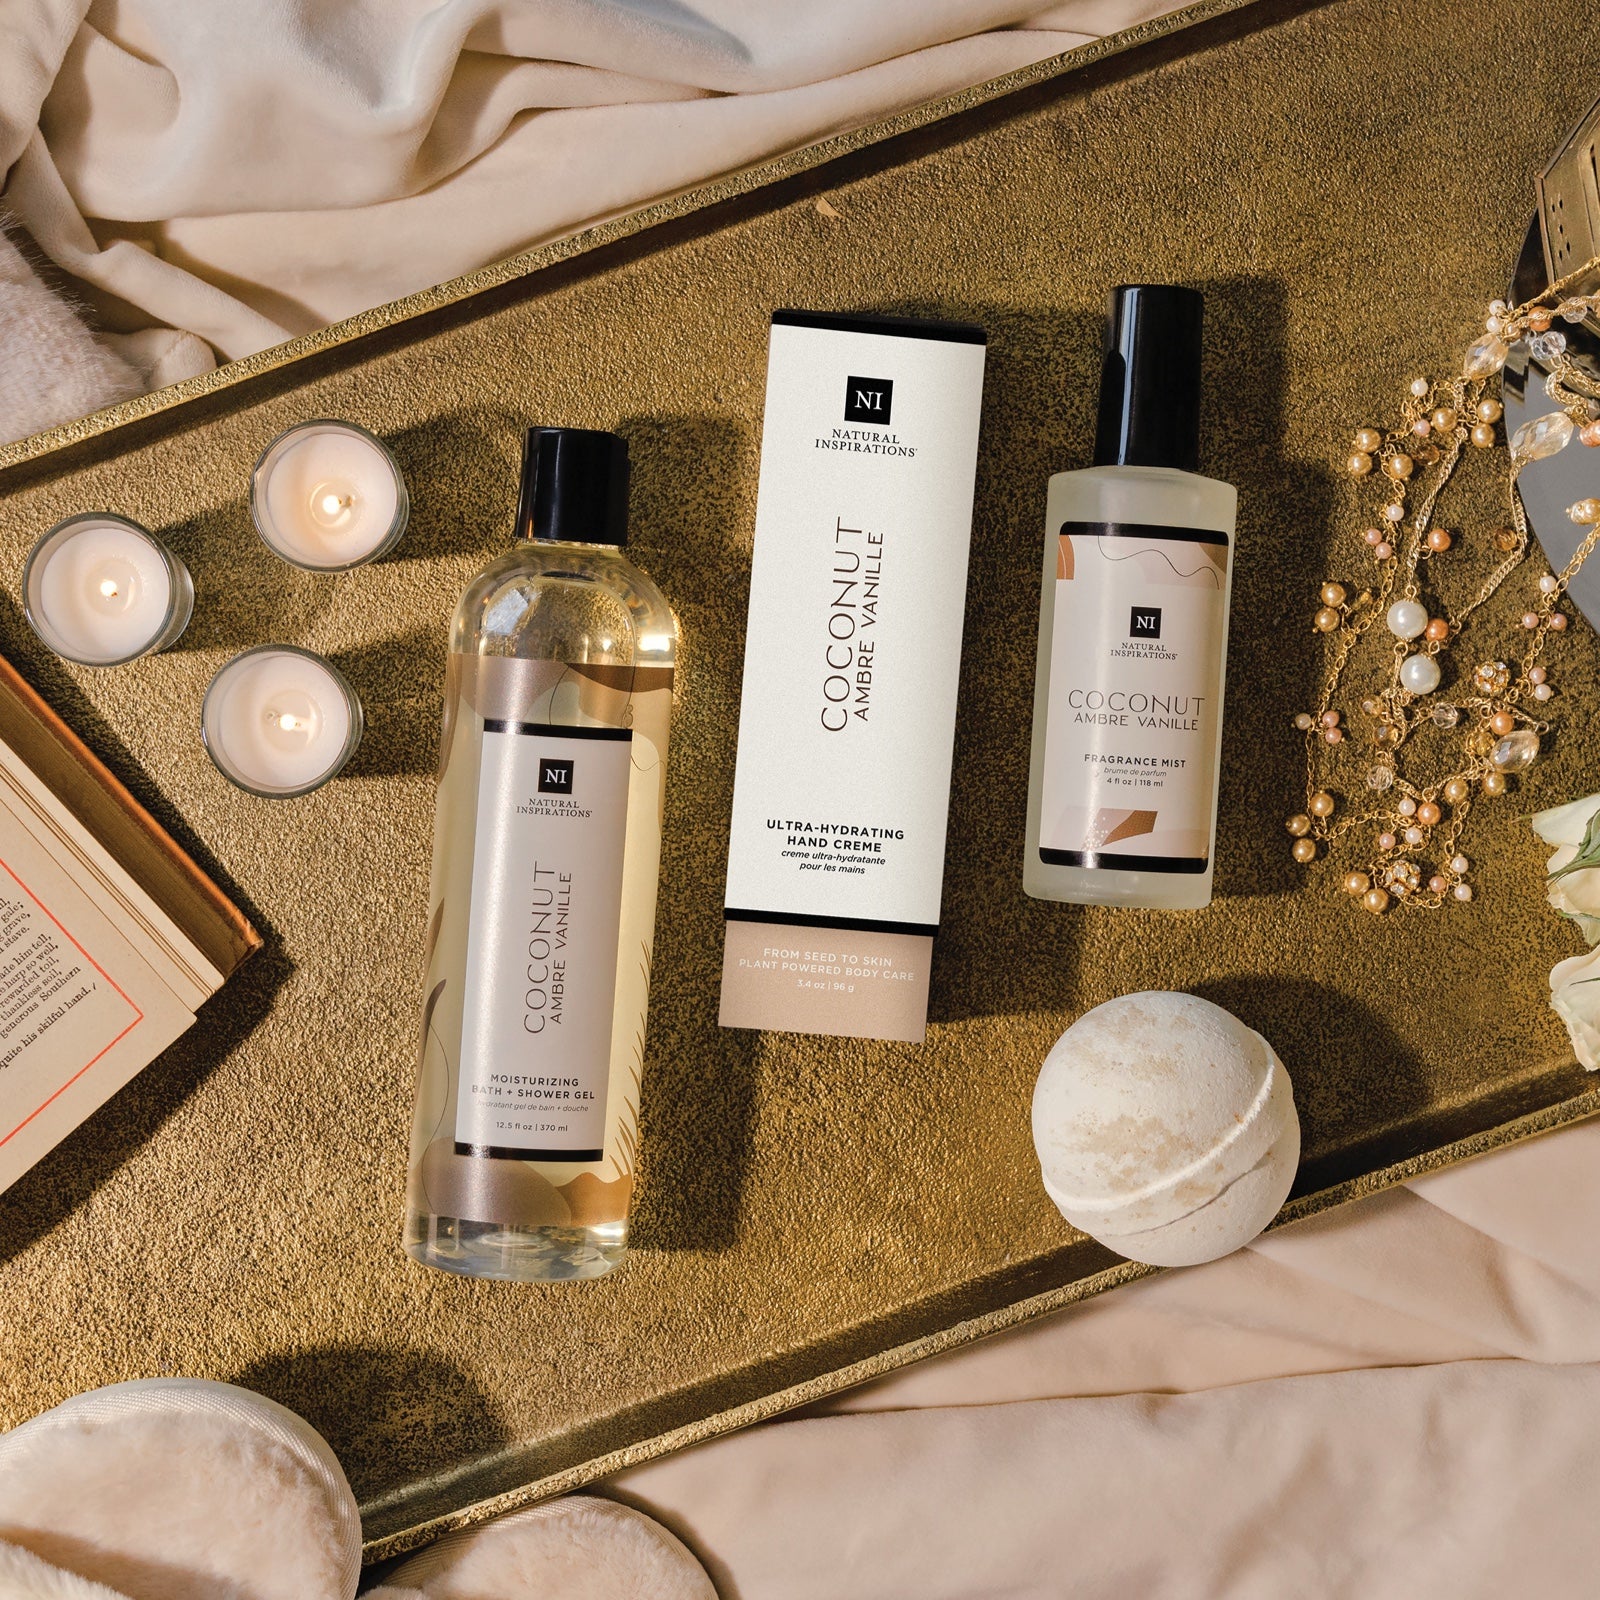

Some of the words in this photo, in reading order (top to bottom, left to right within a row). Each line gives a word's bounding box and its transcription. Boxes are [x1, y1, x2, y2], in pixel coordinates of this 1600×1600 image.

[854, 390, 884, 411] NI
[832, 428, 900, 445] NATURAL
[861, 532, 884, 628] VANILLE
[821, 516, 862, 732] COCONUT
[1136, 615, 1156, 630] NI
[1121, 642, 1167, 652] NATURAL
[854, 640, 875, 722] AMBRE
[1068, 689, 1205, 716] COCONUT
[1073, 712, 1129, 727] AMBRE
[1137, 716, 1199, 731] VANILLE
[1084, 754, 1158, 767] FRAGRANCE
[1161, 758, 1186, 768] MIST
[544, 768, 568, 784] NI
[1103, 766, 1129, 776] brume
[1130, 768, 1140, 776] de
[1140, 769, 1168, 778] parfum
[1140, 779, 1152, 787] 118
[528, 798, 580, 808] NATURAL
[766, 818, 905, 840] ULTRA-HYDRATING
[786, 835, 828, 848] HAND
[833, 839, 882, 853] CREME
[781, 850, 810, 859] creme
[812, 851, 886, 866] ultra-hydratante
[799, 862, 822, 872] pour
[823, 863, 836, 872] les
[838, 866, 866, 875] mains
[1, 901, 24, 923] gale;
[554, 872, 572, 950] VANILLE
[3, 912, 30, 936] grave,
[4, 927, 30, 948] stave.
[523, 860, 556, 1034] COCONUT
[0, 966, 15, 980] ade
[12, 949, 33, 966] him
[32, 934, 52, 950] tell,
[4, 970, 26, 989] harp
[26, 960, 36, 970] so
[36, 942, 58, 960] well,
[764, 948, 800, 960] FROM
[804, 952, 836, 962] SEED
[842, 954, 858, 964] TO
[863, 956, 892, 967] SKIN
[739, 958, 778, 970] PLANT
[782, 962, 841, 976] POWERED
[845, 967, 879, 978] BODY
[883, 970, 915, 982] CARE
[0, 970, 40, 1008] rewarded
[39, 956, 60, 972] toil,
[550, 959, 566, 1024] AMBRE
[797, 980, 812, 988] 3.4
[814, 982, 826, 990] oz
[833, 982, 846, 991] 96
[848, 984, 855, 993] g
[0, 984, 42, 1021] thankless
[42, 968, 62, 986] soil,
[0, 1002, 39, 1039] generous
[40, 966, 81, 1002] Southern
[0, 1046, 22, 1070] quite
[20, 1032, 38, 1047] his
[38, 1006, 66, 1034] skilful
[64, 987, 91, 1010] hand.
[490, 1074, 580, 1087] MOISTURIZING
[472, 1084, 502, 1096] BATH
[518, 1088, 570, 1099] SHOWER
[574, 1091, 595, 1100] GEL
[496, 1122, 512, 1130] 12.5
